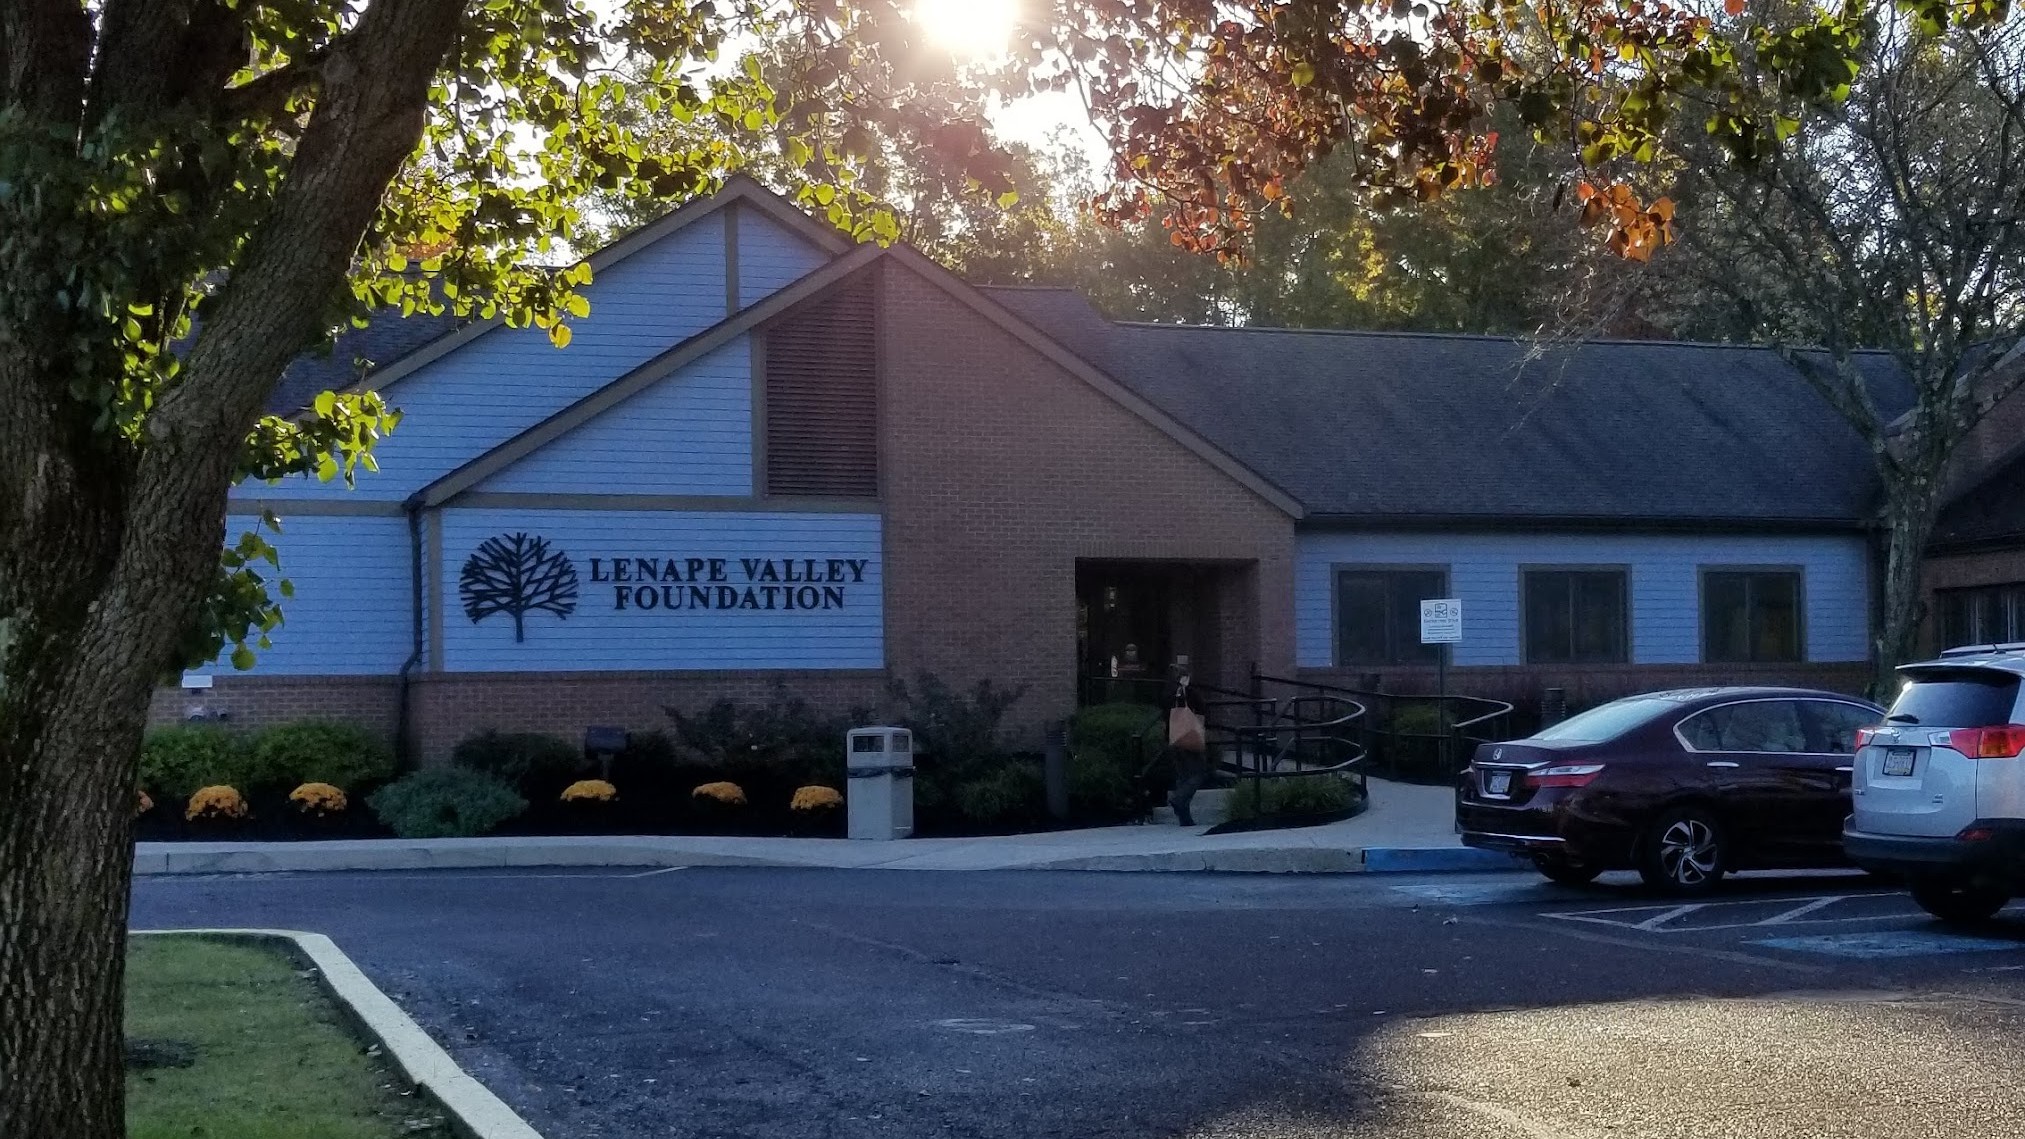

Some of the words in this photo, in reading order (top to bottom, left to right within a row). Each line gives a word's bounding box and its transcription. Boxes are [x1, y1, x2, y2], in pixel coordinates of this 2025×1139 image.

[589, 558, 727, 582] LENAPE
[740, 558, 869, 582] VALLEY
[614, 585, 845, 610] FOUNDATION
